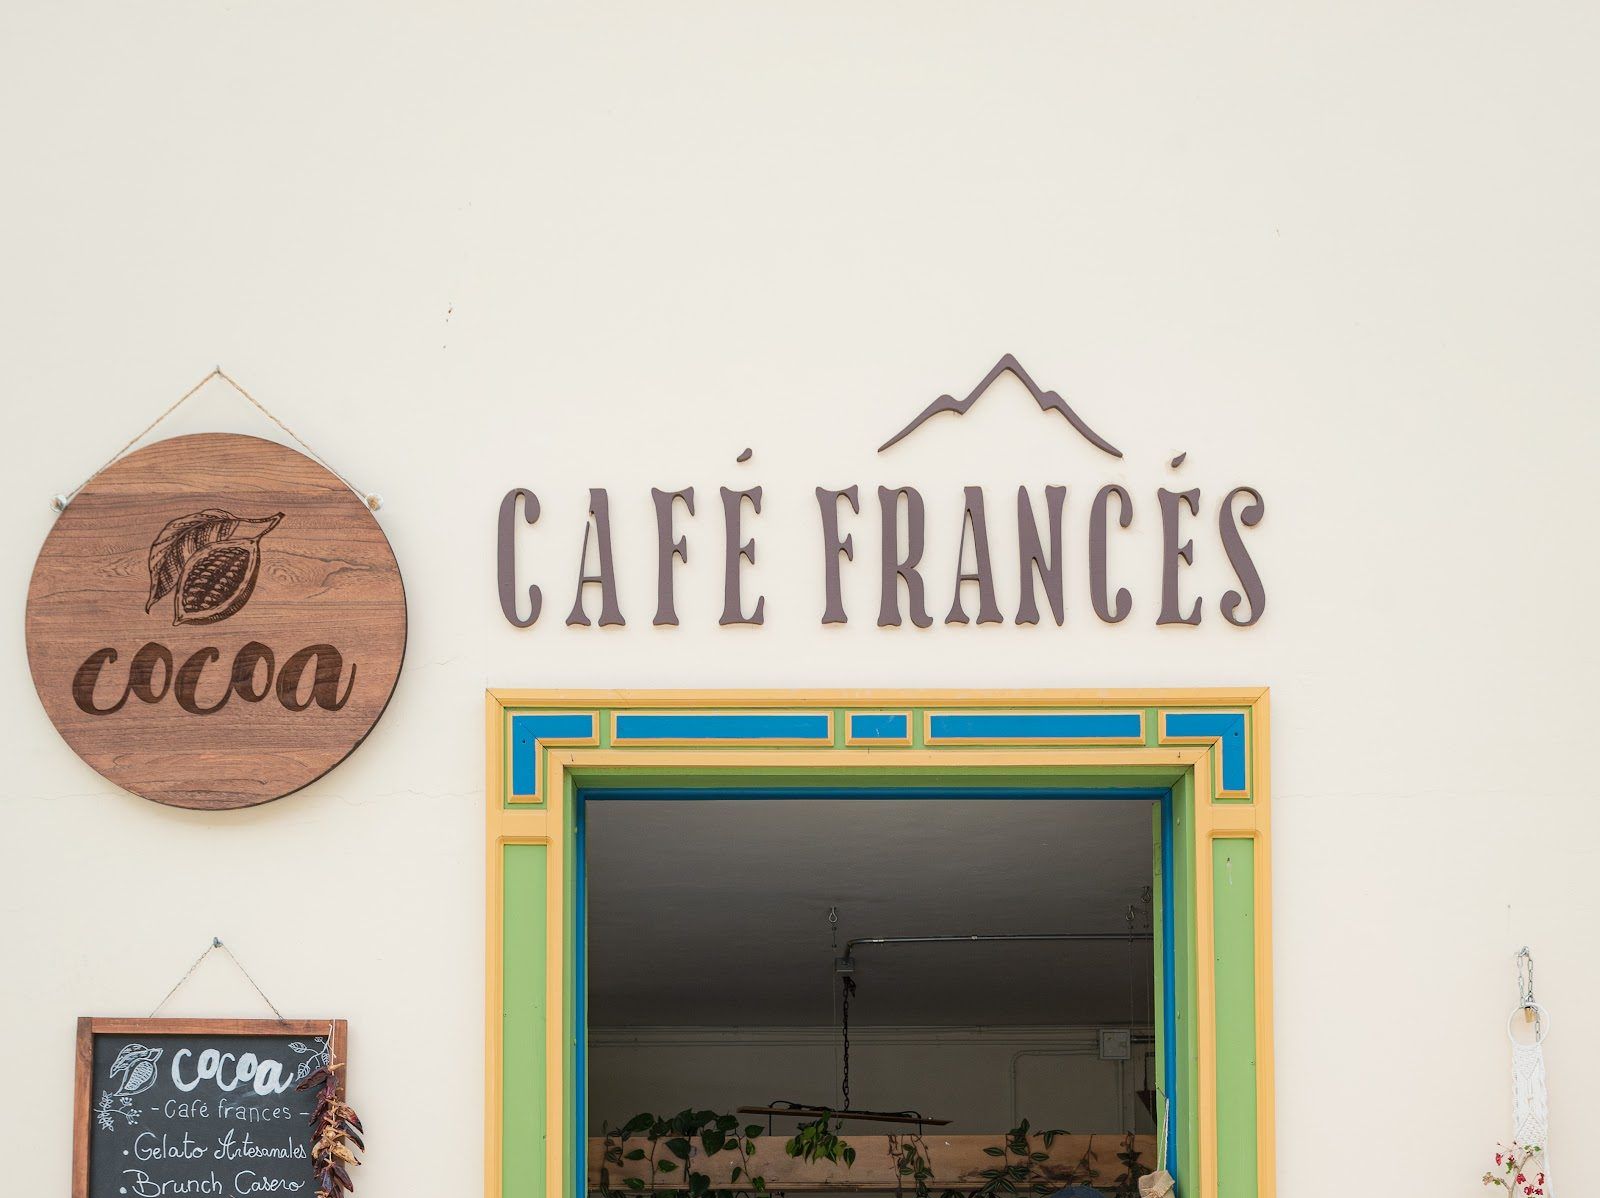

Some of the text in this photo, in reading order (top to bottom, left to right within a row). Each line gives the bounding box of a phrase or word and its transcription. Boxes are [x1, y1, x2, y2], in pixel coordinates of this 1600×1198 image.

[496, 447, 1266, 629] CAFÉ FRANCÉS
[71, 640, 357, 716] cocoa
[171, 1048, 294, 1096] cocoa
[164, 1098, 292, 1122] Café frances
[134, 1128, 308, 1161] Gelato Artesanales
[123, 1168, 306, 1198] Brunch Casero
